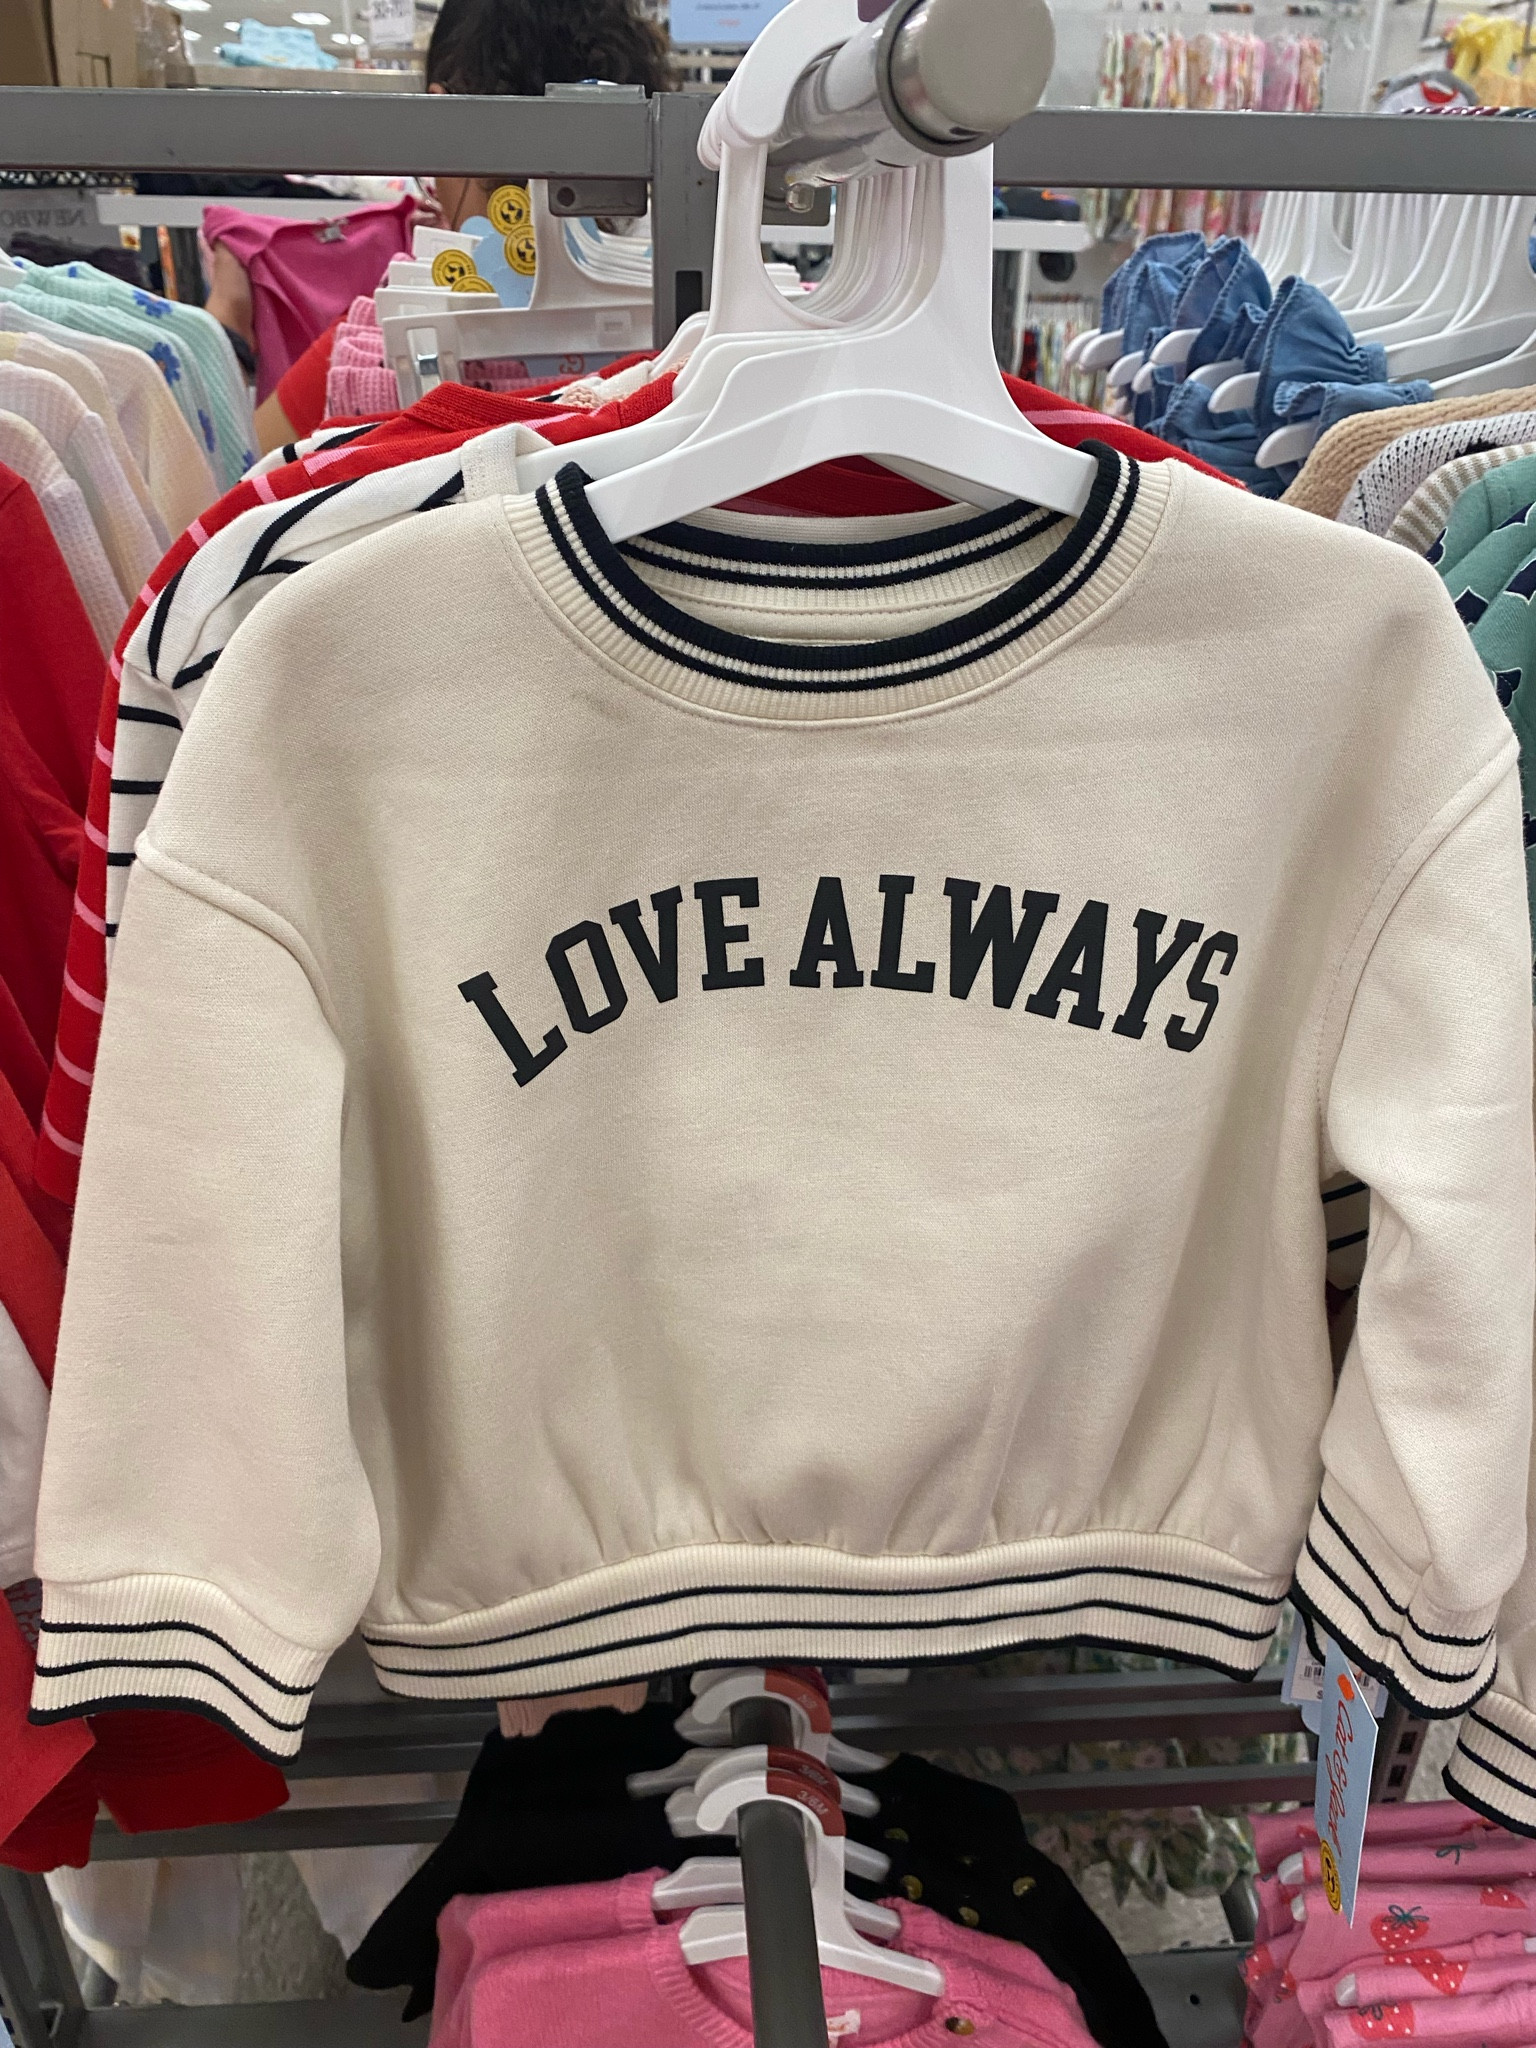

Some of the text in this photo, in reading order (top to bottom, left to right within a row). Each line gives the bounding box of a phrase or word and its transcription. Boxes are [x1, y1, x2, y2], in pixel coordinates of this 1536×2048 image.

[458, 875, 1238, 1087] LOVE ALWAYS
[1335, 1700, 1353, 1764] Cat
[1333, 1750, 1348, 1792] &
[798, 1791, 828, 1815] 3/6M
